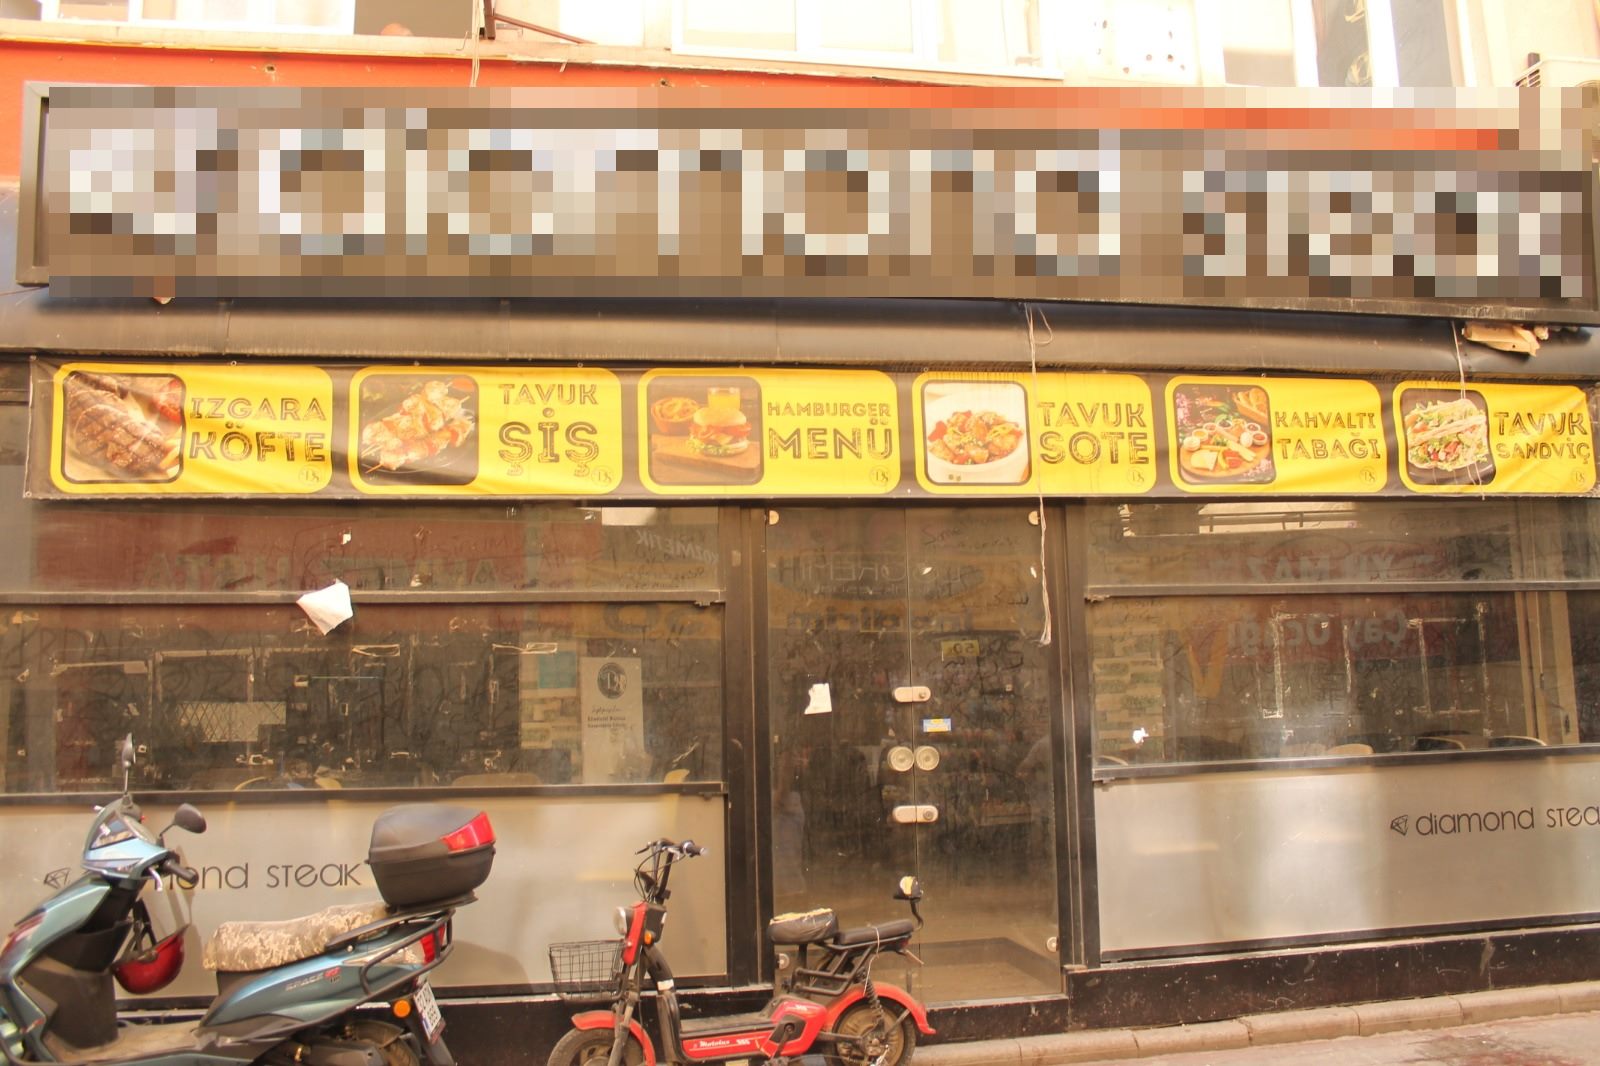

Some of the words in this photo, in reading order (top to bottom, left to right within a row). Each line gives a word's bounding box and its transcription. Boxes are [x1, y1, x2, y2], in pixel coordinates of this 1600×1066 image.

[498, 384, 599, 405] TAVUK
[190, 397, 327, 421] IZGARA
[767, 402, 892, 417] HAMBURGER
[1037, 402, 1147, 428] TAVUK
[1274, 411, 1377, 429] KAHVALTI
[1493, 412, 1588, 436] TAVUK
[189, 421, 327, 462] KÖFTE
[498, 407, 599, 477] ŞİŞ
[768, 417, 893, 460] MENÜ
[1040, 431, 1149, 464] SOTE
[1277, 432, 1381, 459] TABAĞI
[1496, 437, 1591, 464] SANDVİÇ
[1416, 807, 1535, 836] diamond
